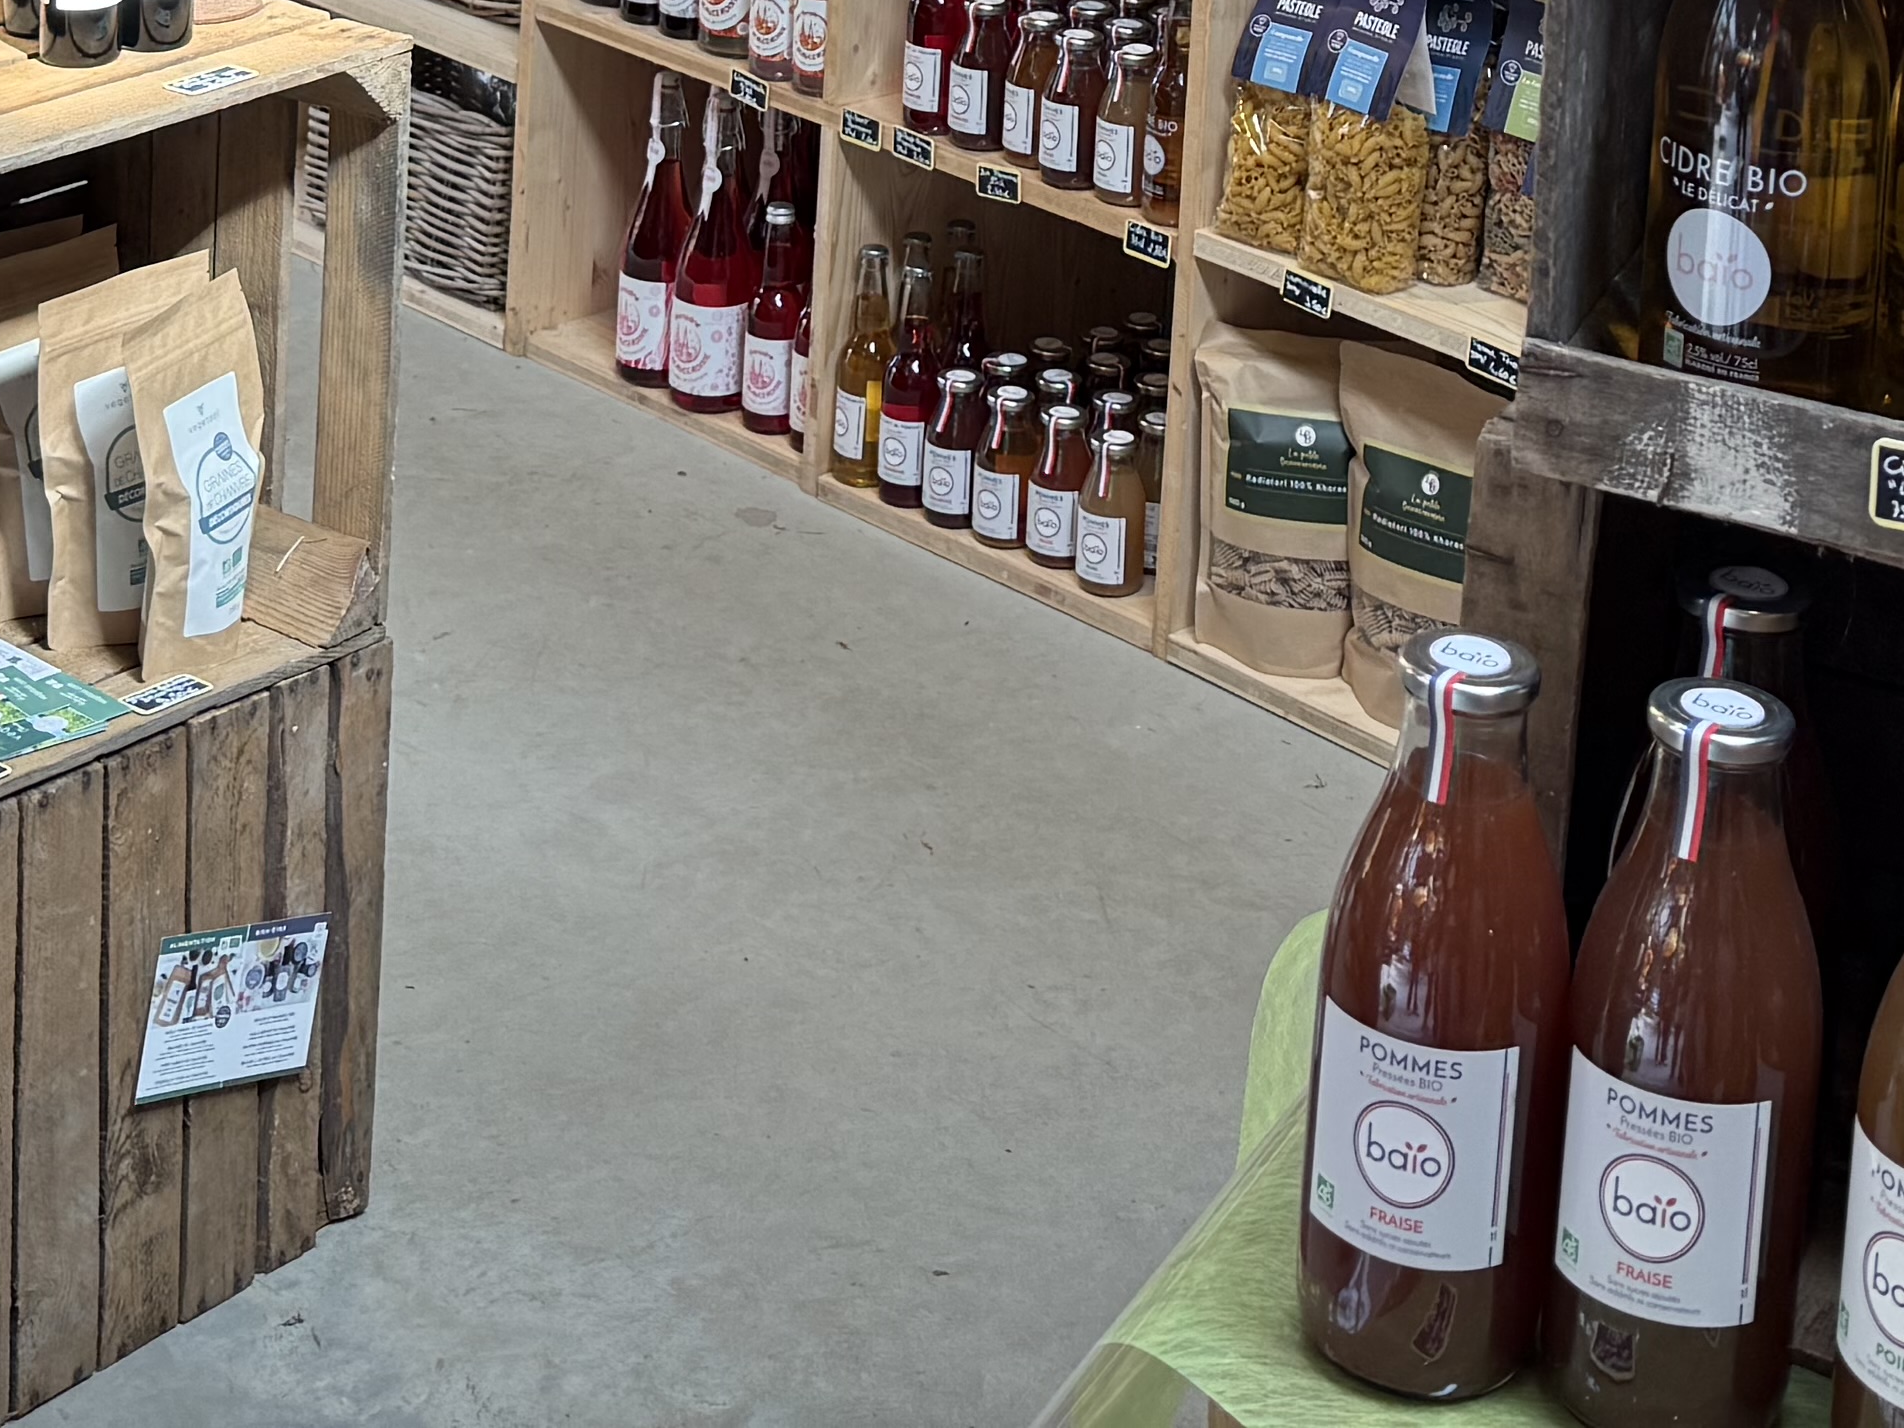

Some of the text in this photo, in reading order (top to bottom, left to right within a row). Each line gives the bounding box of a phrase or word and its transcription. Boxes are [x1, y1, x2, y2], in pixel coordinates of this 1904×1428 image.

[1353, 11, 1400, 39] PASTEOLE
[1660, 135, 1808, 198] CIDRE BIO
[1681, 180, 1759, 213] LE DÉLICAT
[1676, 232, 1754, 291] baïo
[203, 460, 244, 493] GRAINES
[1290, 476, 1313, 491] 100%
[1441, 641, 1500, 669] baïo
[1691, 691, 1754, 722] baïo
[1359, 1035, 1464, 1081] POMMES
[1372, 1062, 1443, 1092] Pressées BIO
[1606, 1087, 1714, 1134] POMMES
[1620, 1115, 1694, 1145] Pressées BIO
[1366, 1121, 1442, 1178] baïo
[1612, 1175, 1692, 1232] baïo
[1369, 1206, 1424, 1235] FRAISE
[1616, 1260, 1674, 1290] FRAISE
